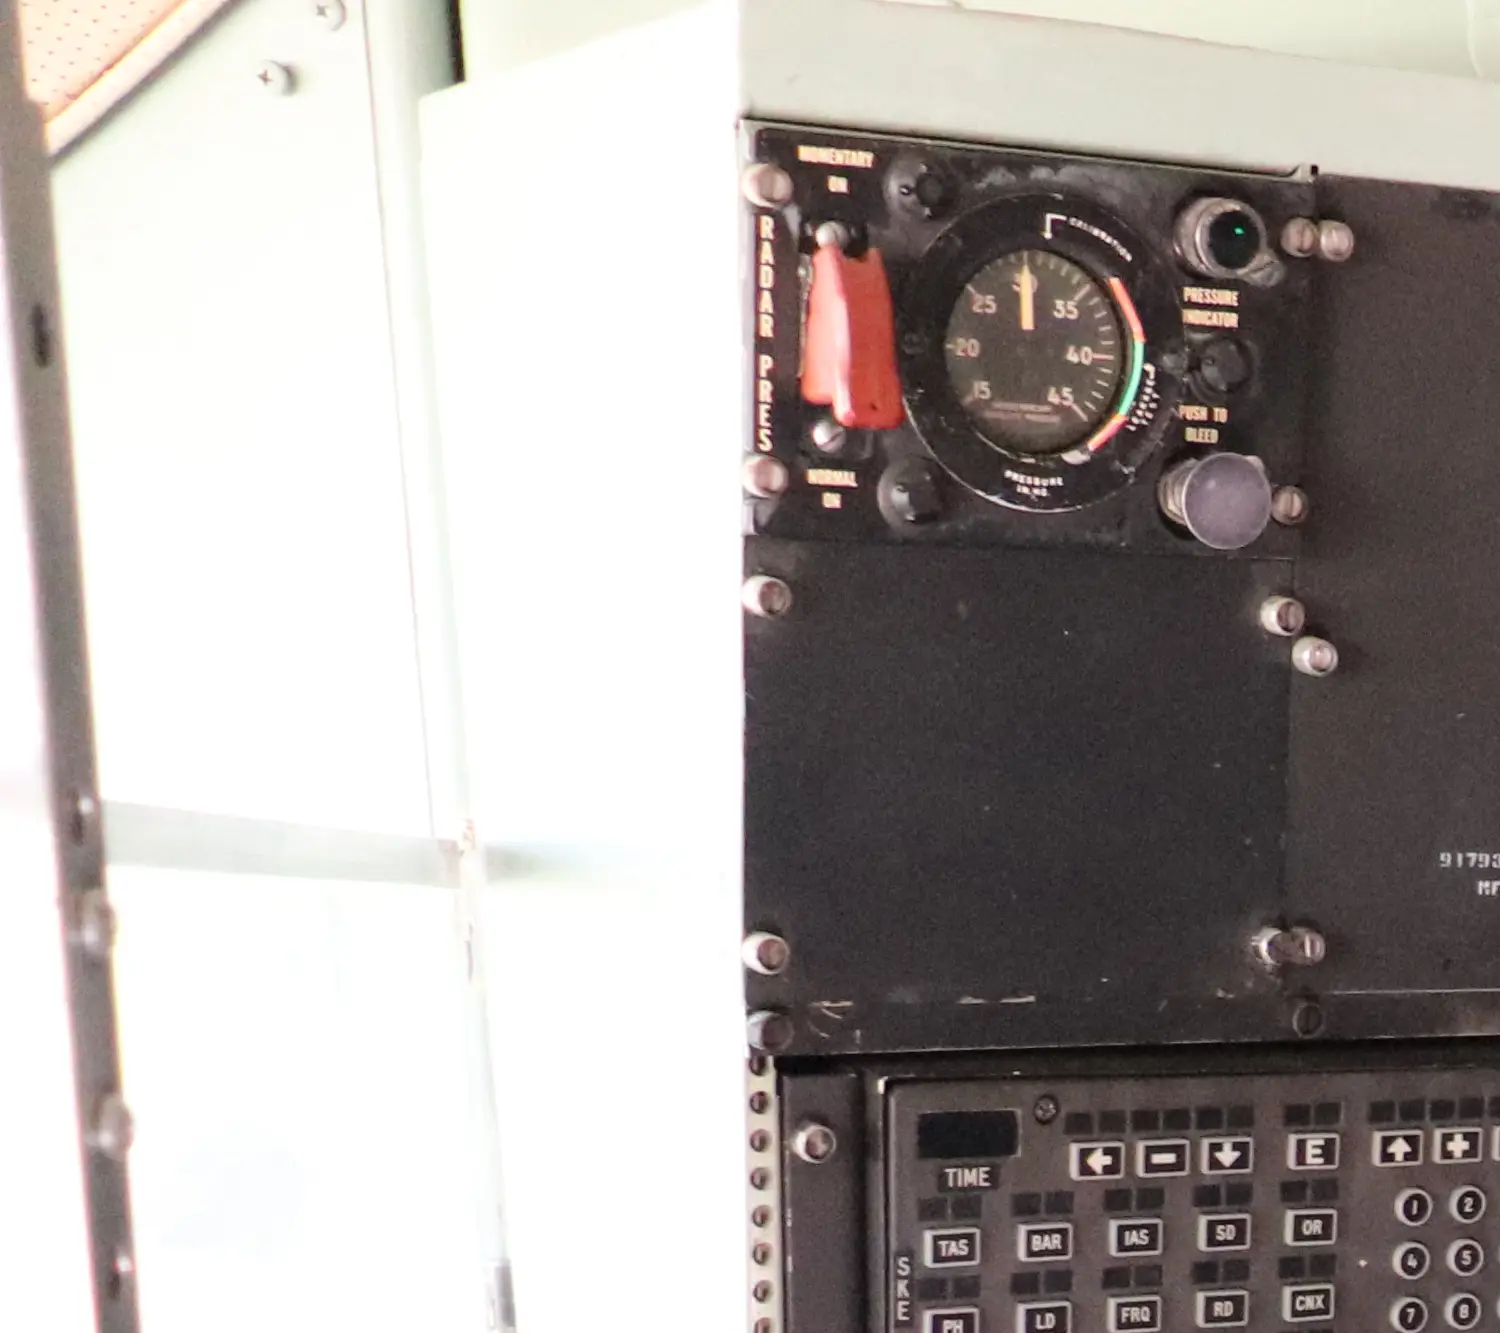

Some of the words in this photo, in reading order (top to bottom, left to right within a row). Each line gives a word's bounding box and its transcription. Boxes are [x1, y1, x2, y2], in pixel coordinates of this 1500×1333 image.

[1053, 300, 1079, 320] 35
[1065, 346, 1093, 366] 40
[973, 381, 991, 400] 15
[944, 1167, 992, 1188] TIME
[1302, 1218, 1324, 1236] OR
[939, 1238, 970, 1256] TAS
[1031, 1233, 1063, 1252] BAR
[1123, 1229, 1151, 1247] IAS
[1120, 1306, 1151, 1324] FRQ
[1213, 1301, 1235, 1318] RD
[1036, 1314, 1056, 1331] LD
